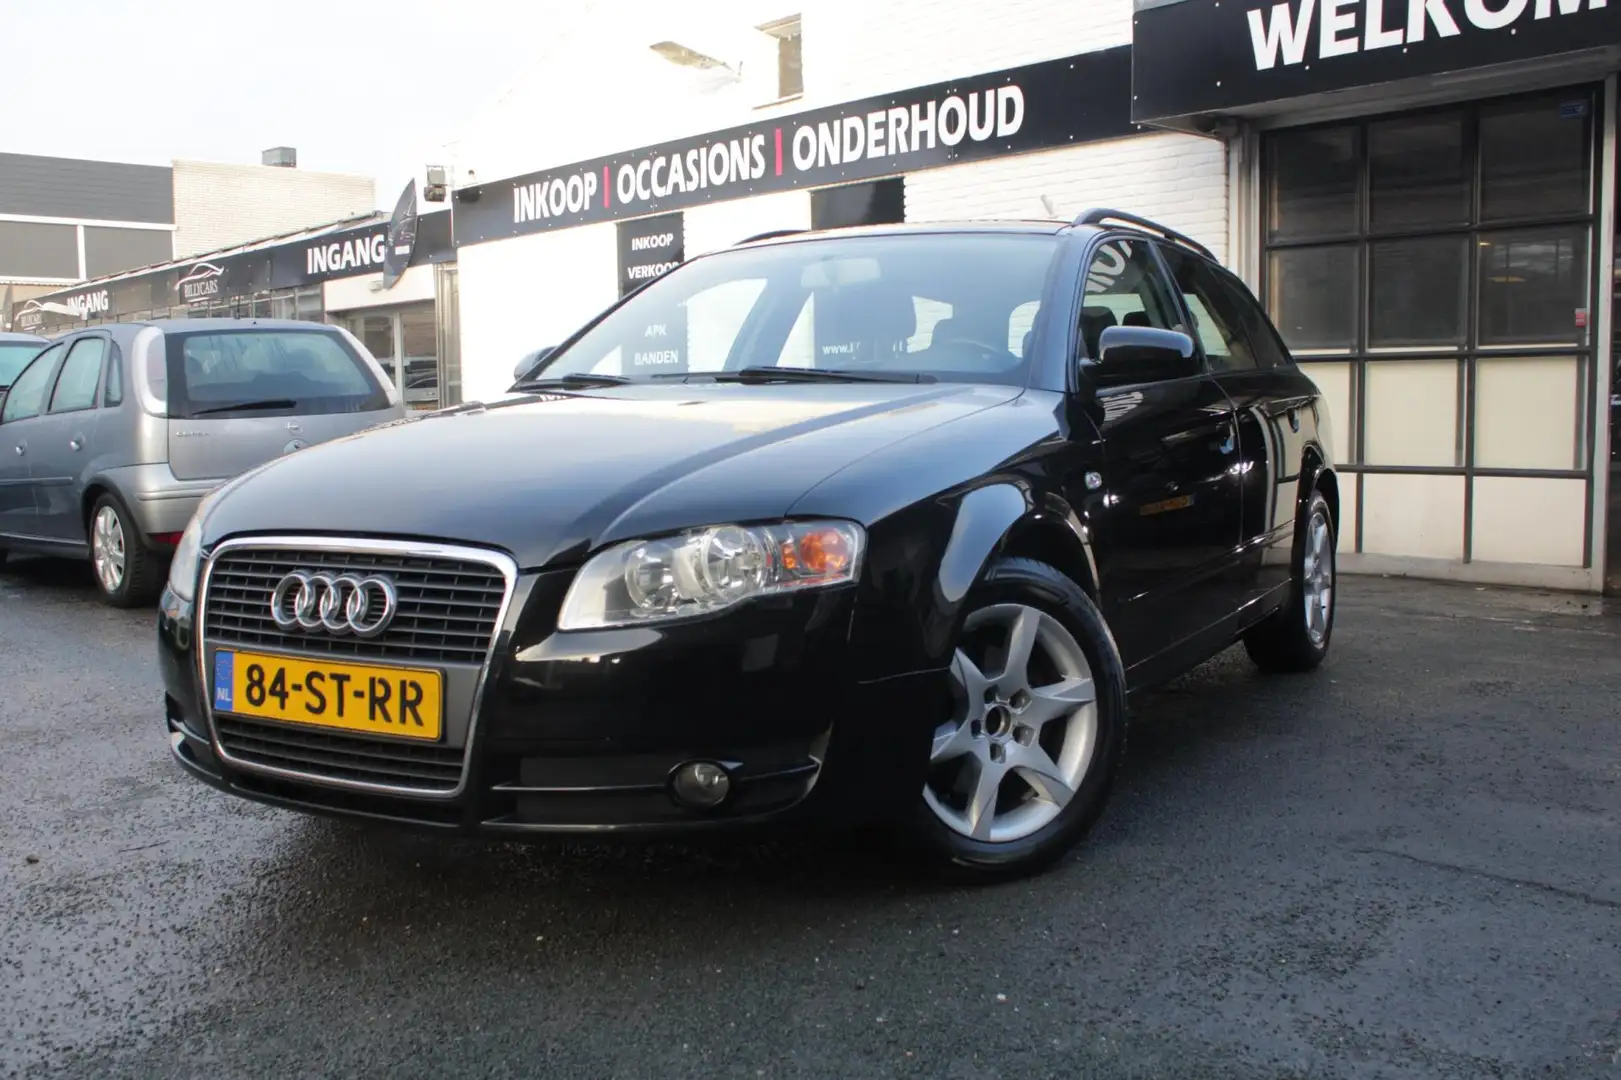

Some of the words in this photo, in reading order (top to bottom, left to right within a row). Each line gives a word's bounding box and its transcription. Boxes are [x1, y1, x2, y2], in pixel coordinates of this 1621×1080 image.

[513, 172, 597, 223] INKOOP
[617, 133, 766, 204] OCCASIONS
[792, 84, 1025, 171] ONDERHOUD
[631, 232, 674, 251] INKOOP
[307, 234, 385, 275] INGANG
[644, 323, 667, 338] APK
[634, 348, 679, 366] BANDEN
[216, 687, 232, 702] NL
[245, 663, 424, 727] 84-ST-RR
